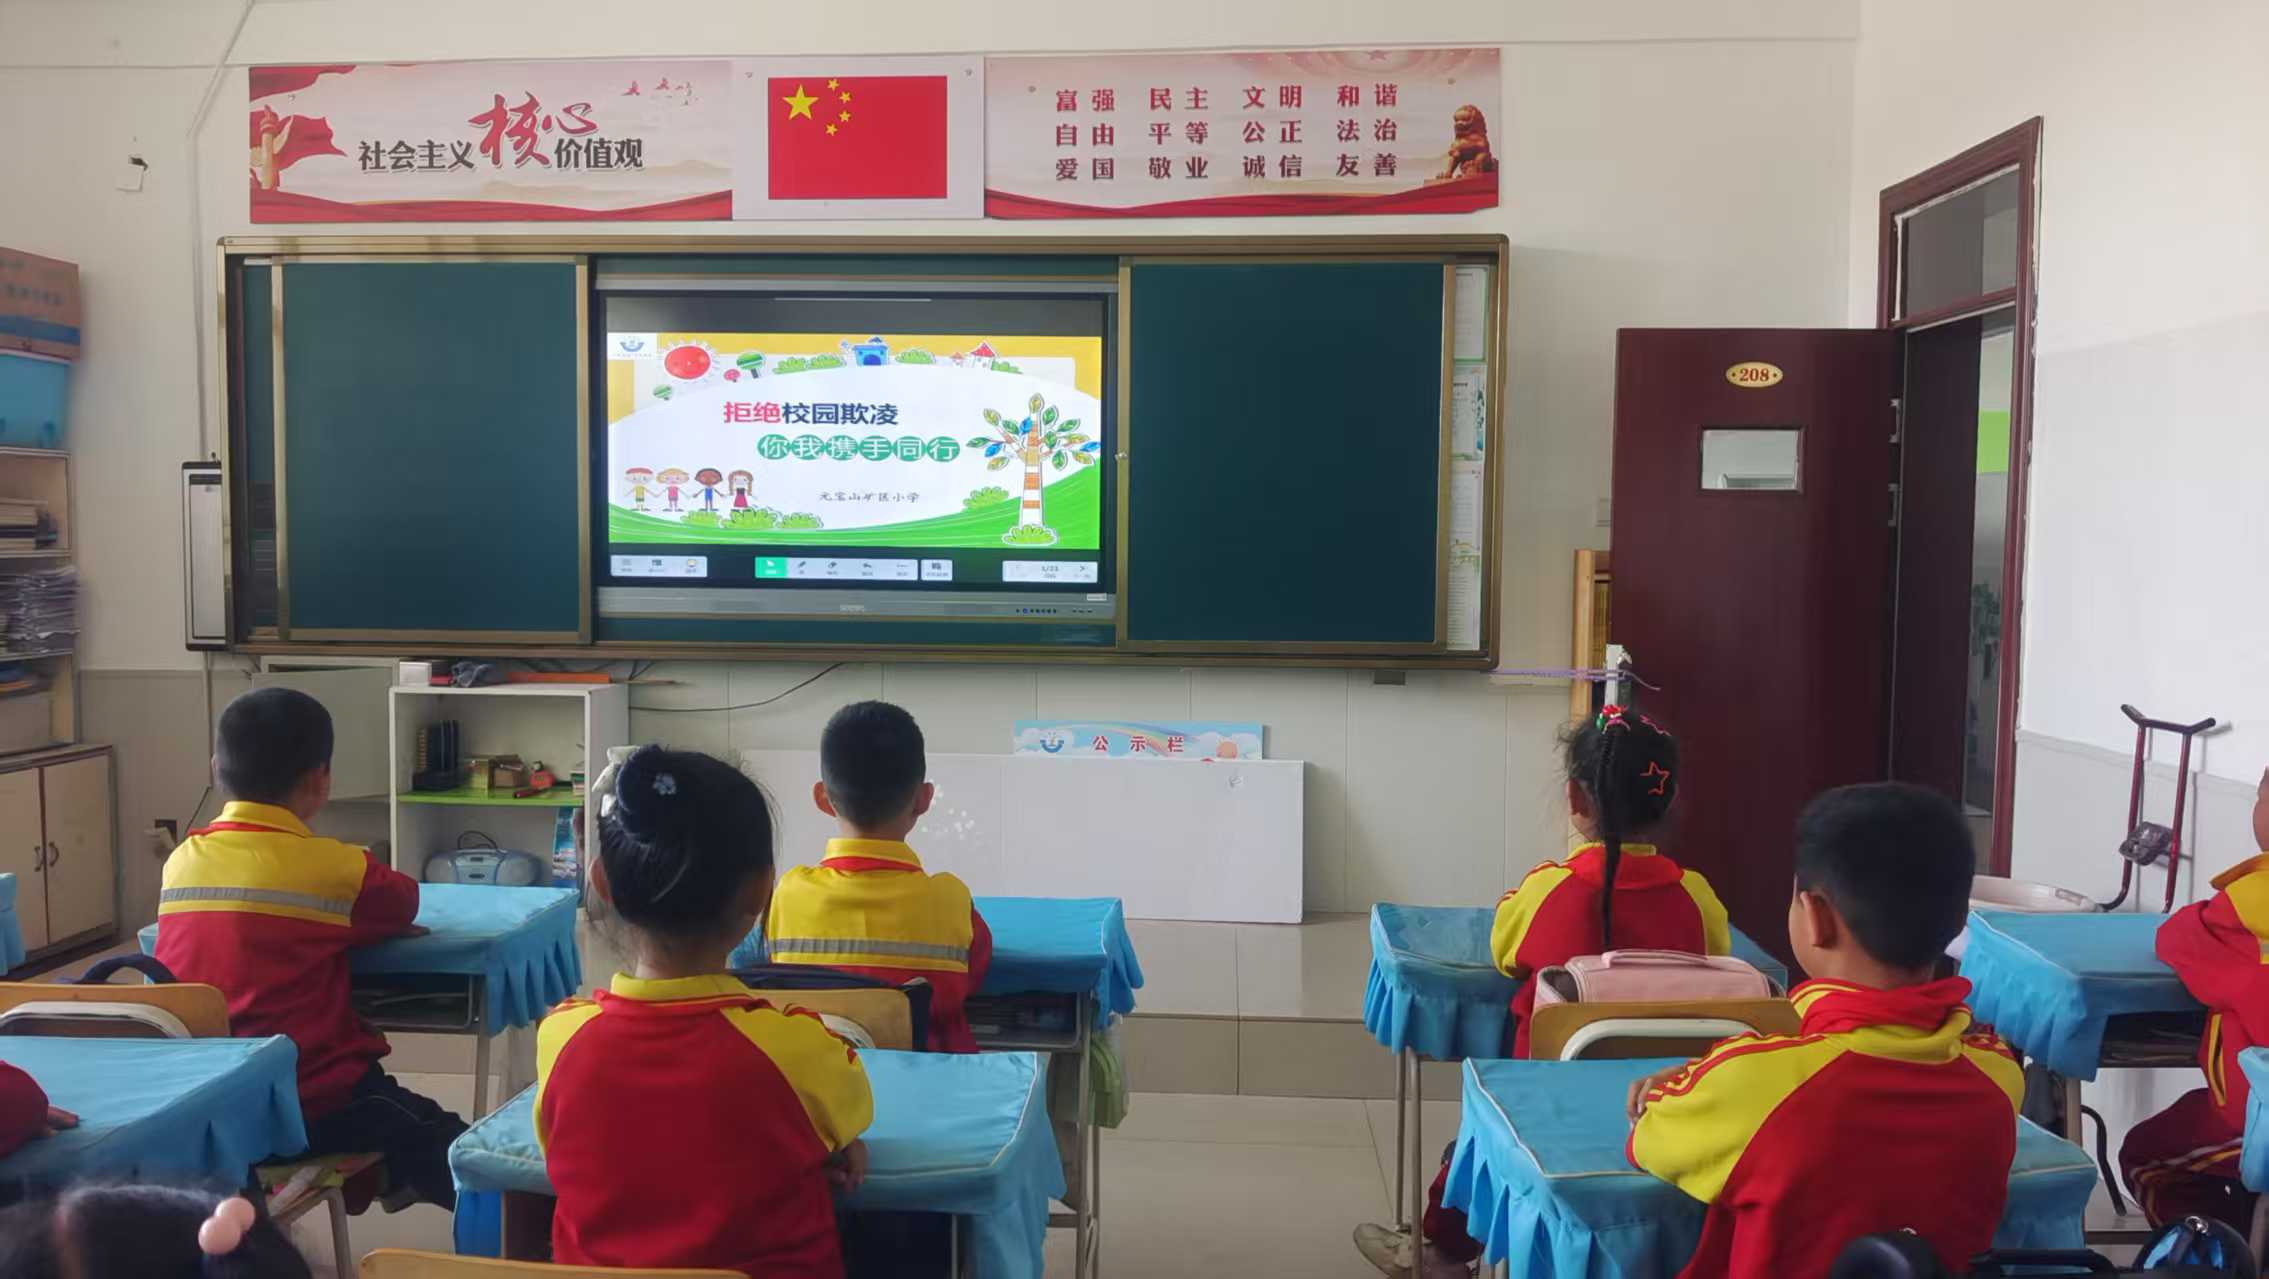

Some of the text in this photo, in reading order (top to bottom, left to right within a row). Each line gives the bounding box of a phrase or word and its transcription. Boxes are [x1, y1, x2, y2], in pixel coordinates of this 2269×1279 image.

[1055, 83, 1398, 113] 富强 民主 文明 和谐
[358, 91, 643, 171] 社会主义 核心 价值观
[1055, 118, 1398, 147] 自由 平等 公正 法治
[1055, 152, 1398, 181] 爱国 敬业 诚信 友善
[1739, 368, 1770, 382] 208
[723, 401, 899, 426] 拒绝校园欺凌
[760, 435, 959, 461] 你我携手同行
[1092, 735, 1184, 753] 公示栏
